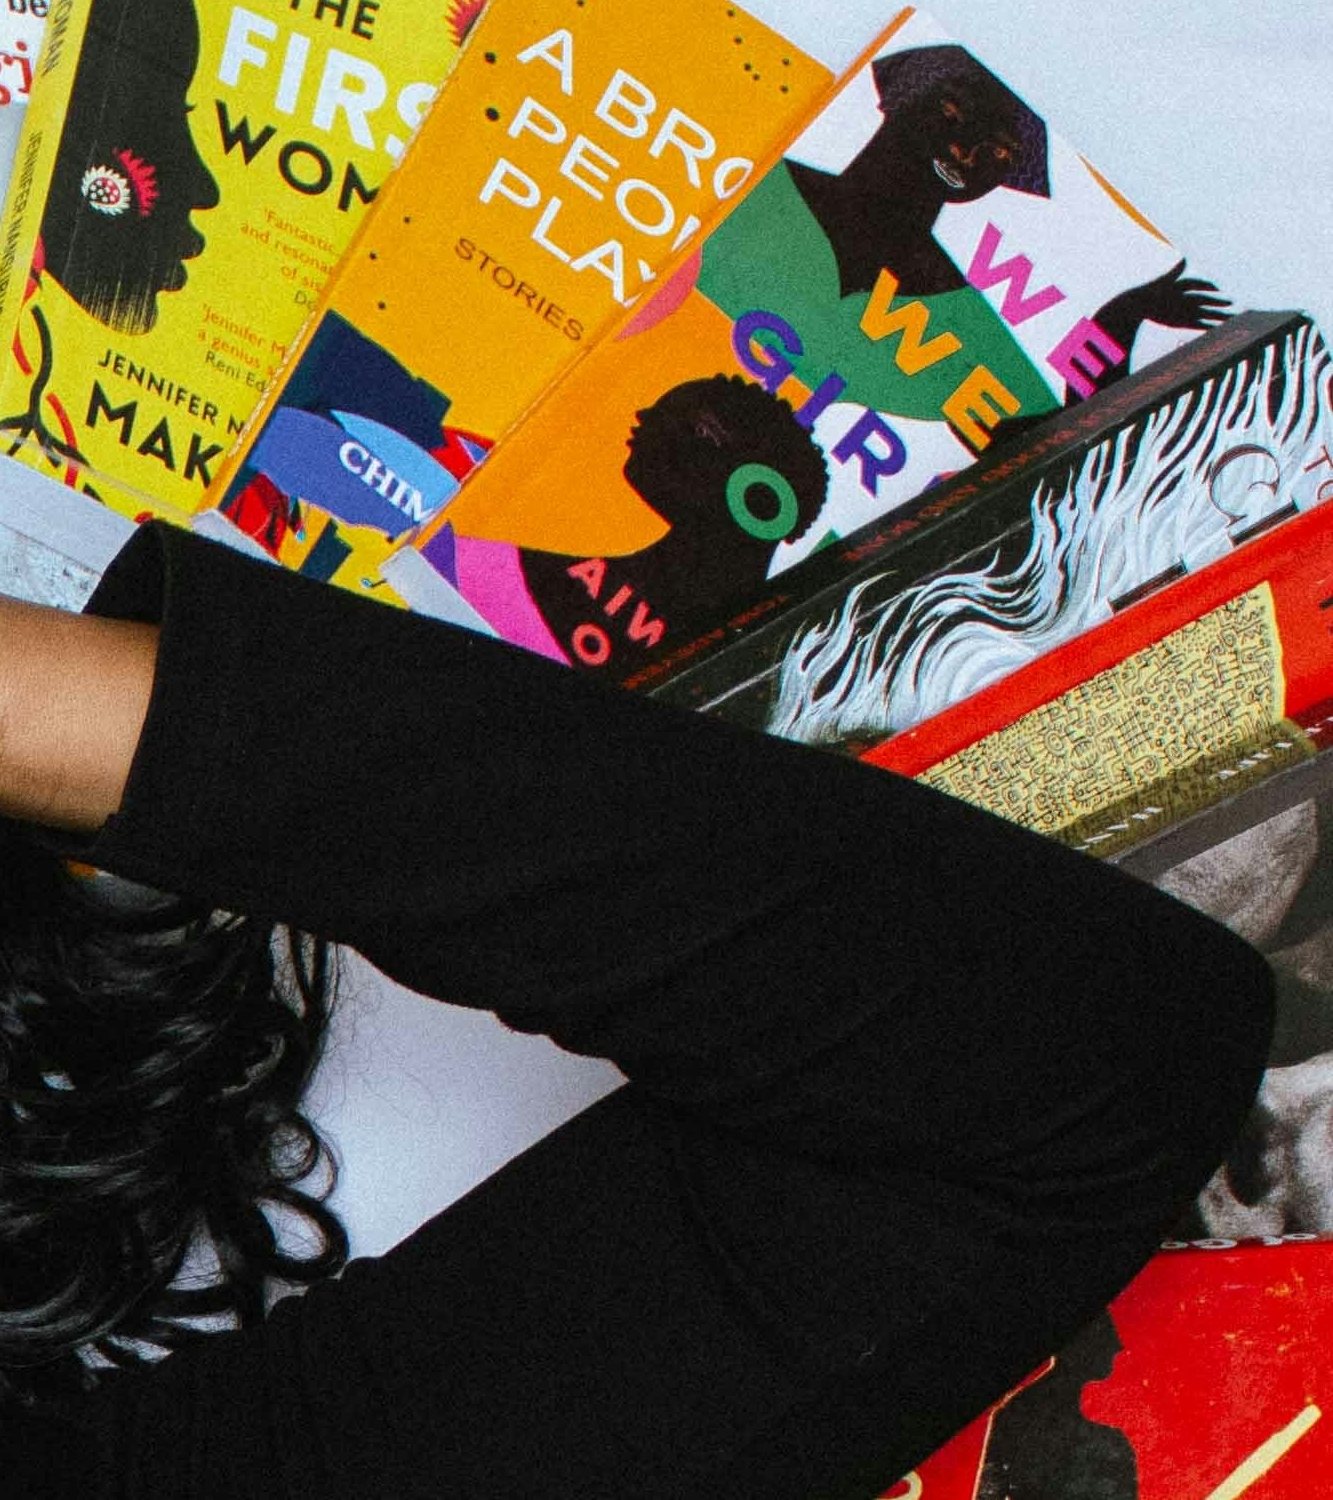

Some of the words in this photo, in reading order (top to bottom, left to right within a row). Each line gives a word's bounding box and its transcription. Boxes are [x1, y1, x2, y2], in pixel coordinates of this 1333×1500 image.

[516, 26, 575, 98] A
[240, 222, 270, 245] and
[454, 236, 585, 343] STORIES
[966, 219, 1129, 400] WE
[97, 349, 220, 426] JENNIFER
